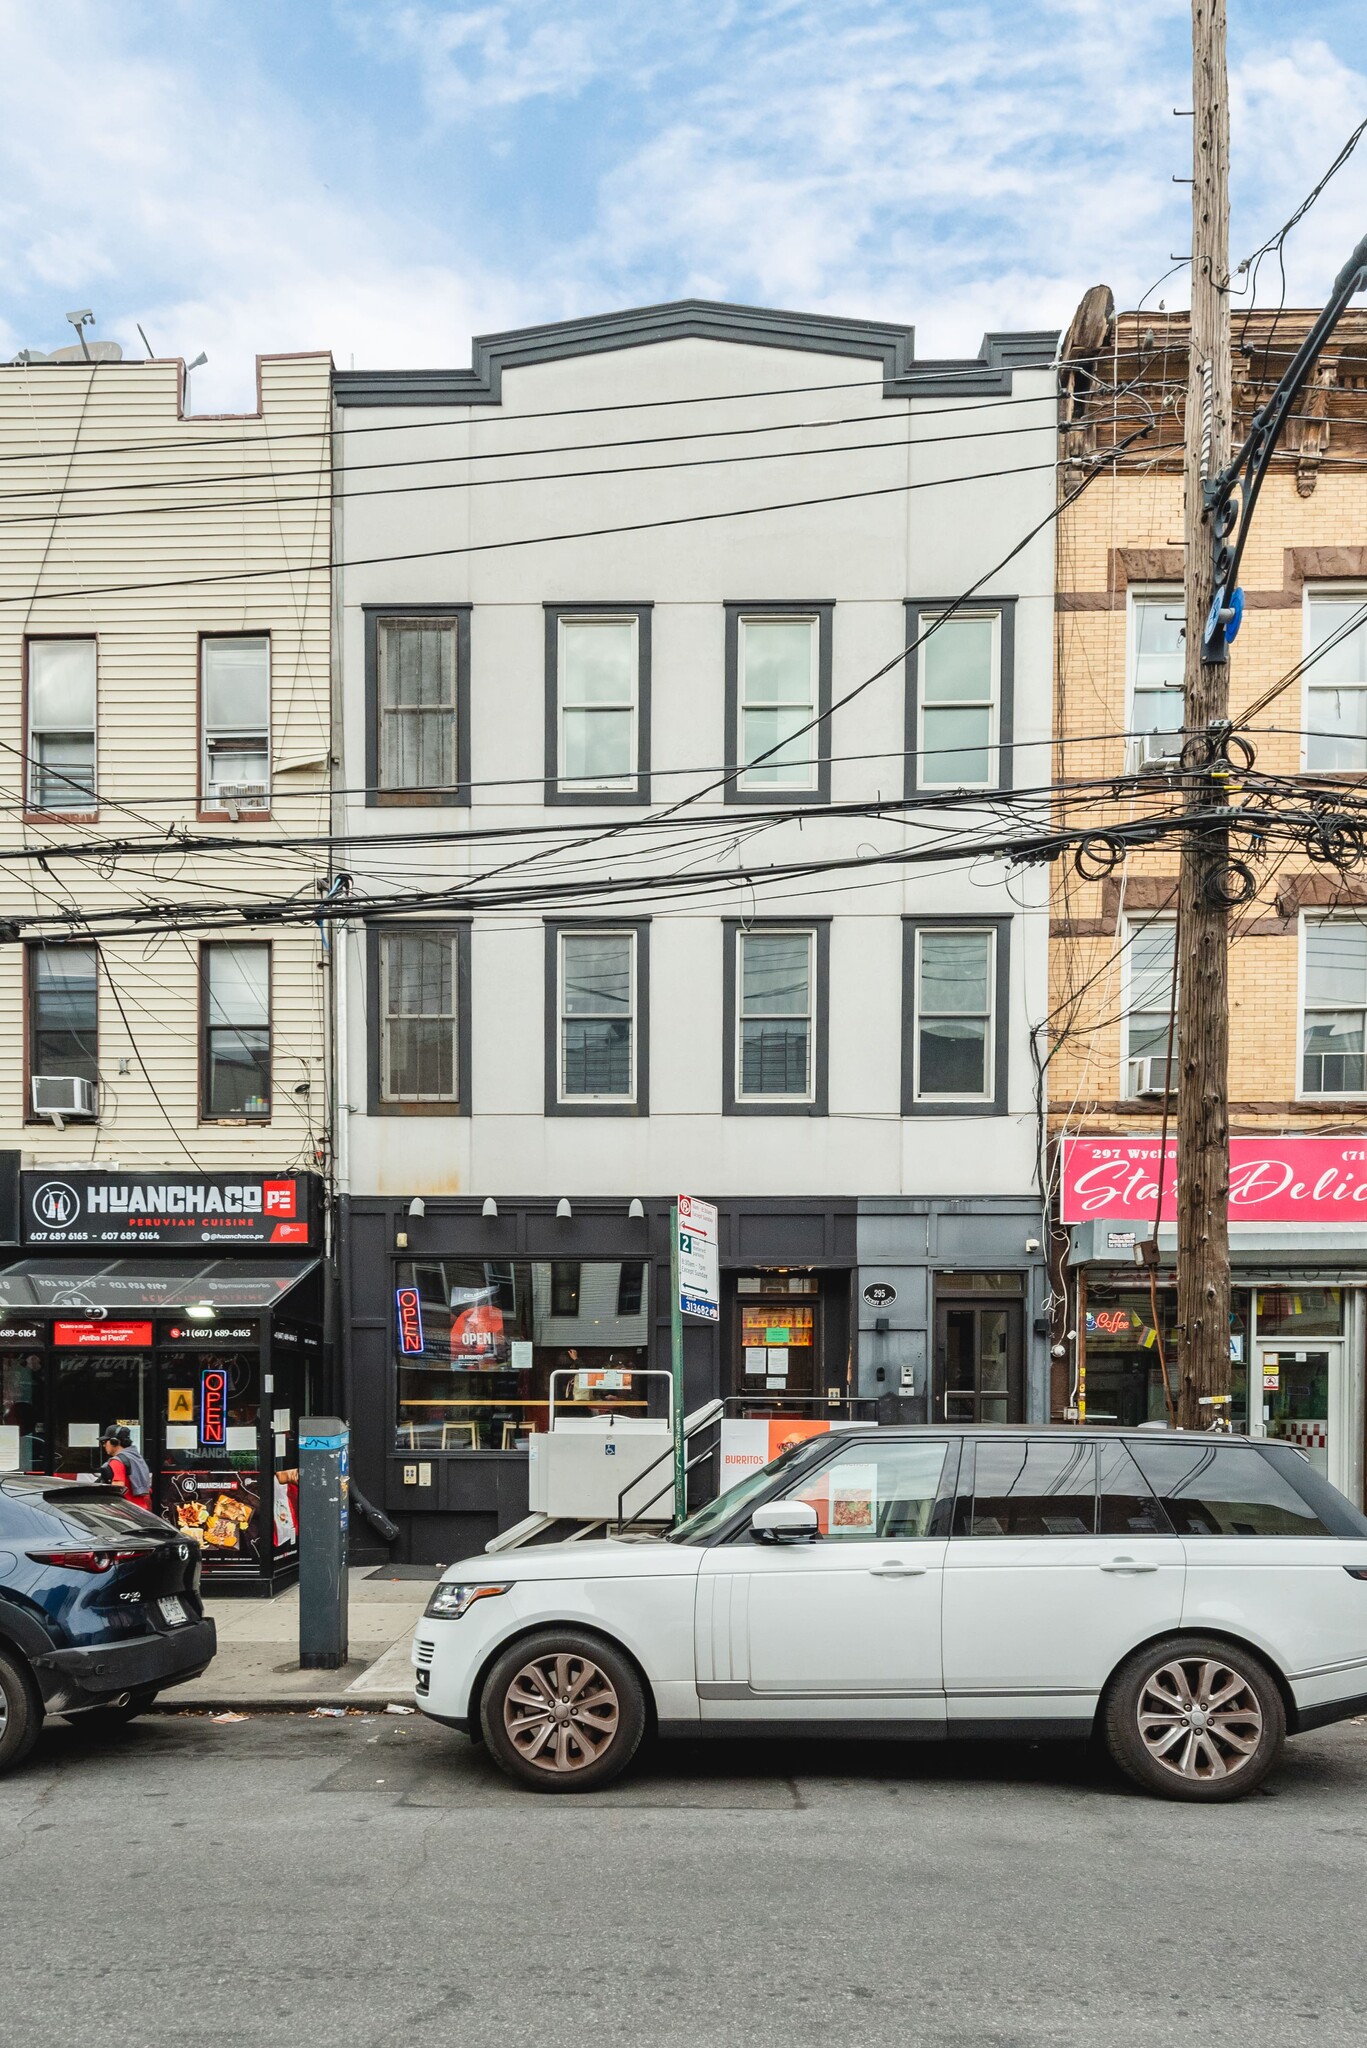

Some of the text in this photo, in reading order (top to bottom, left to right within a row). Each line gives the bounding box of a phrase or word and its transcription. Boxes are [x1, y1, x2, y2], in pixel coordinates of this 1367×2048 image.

[1092, 1149, 1121, 1159] 297
[86, 1186, 291, 1213] HUANCHACO PE
[129, 1218, 254, 1227] PERUVIAN CUISINE
[30, 1232, 48, 1241] 607
[49, 1232, 66, 1240] 689
[67, 1232, 88, 1240] 6165
[101, 1232, 118, 1240] 607
[120, 1232, 137, 1240] 689
[138, 1232, 160, 1240] 6164
[210, 1232, 265, 1241] @huanchaco.pe
[682, 1235, 690, 1252] 2
[873, 1289, 886, 1298] 295
[685, 1301, 709, 1317] 313682
[400, 1292, 420, 1350] OPEN
[1096, 1311, 1130, 1333] Coffee
[191, 1329, 213, 1338] (607)
[214, 1329, 251, 1338] 689-6165
[461, 1331, 492, 1345] OPEN
[174, 1394, 189, 1411] A
[205, 1373, 224, 1441] OPEN
[725, 1455, 764, 1465] BURRITOS
